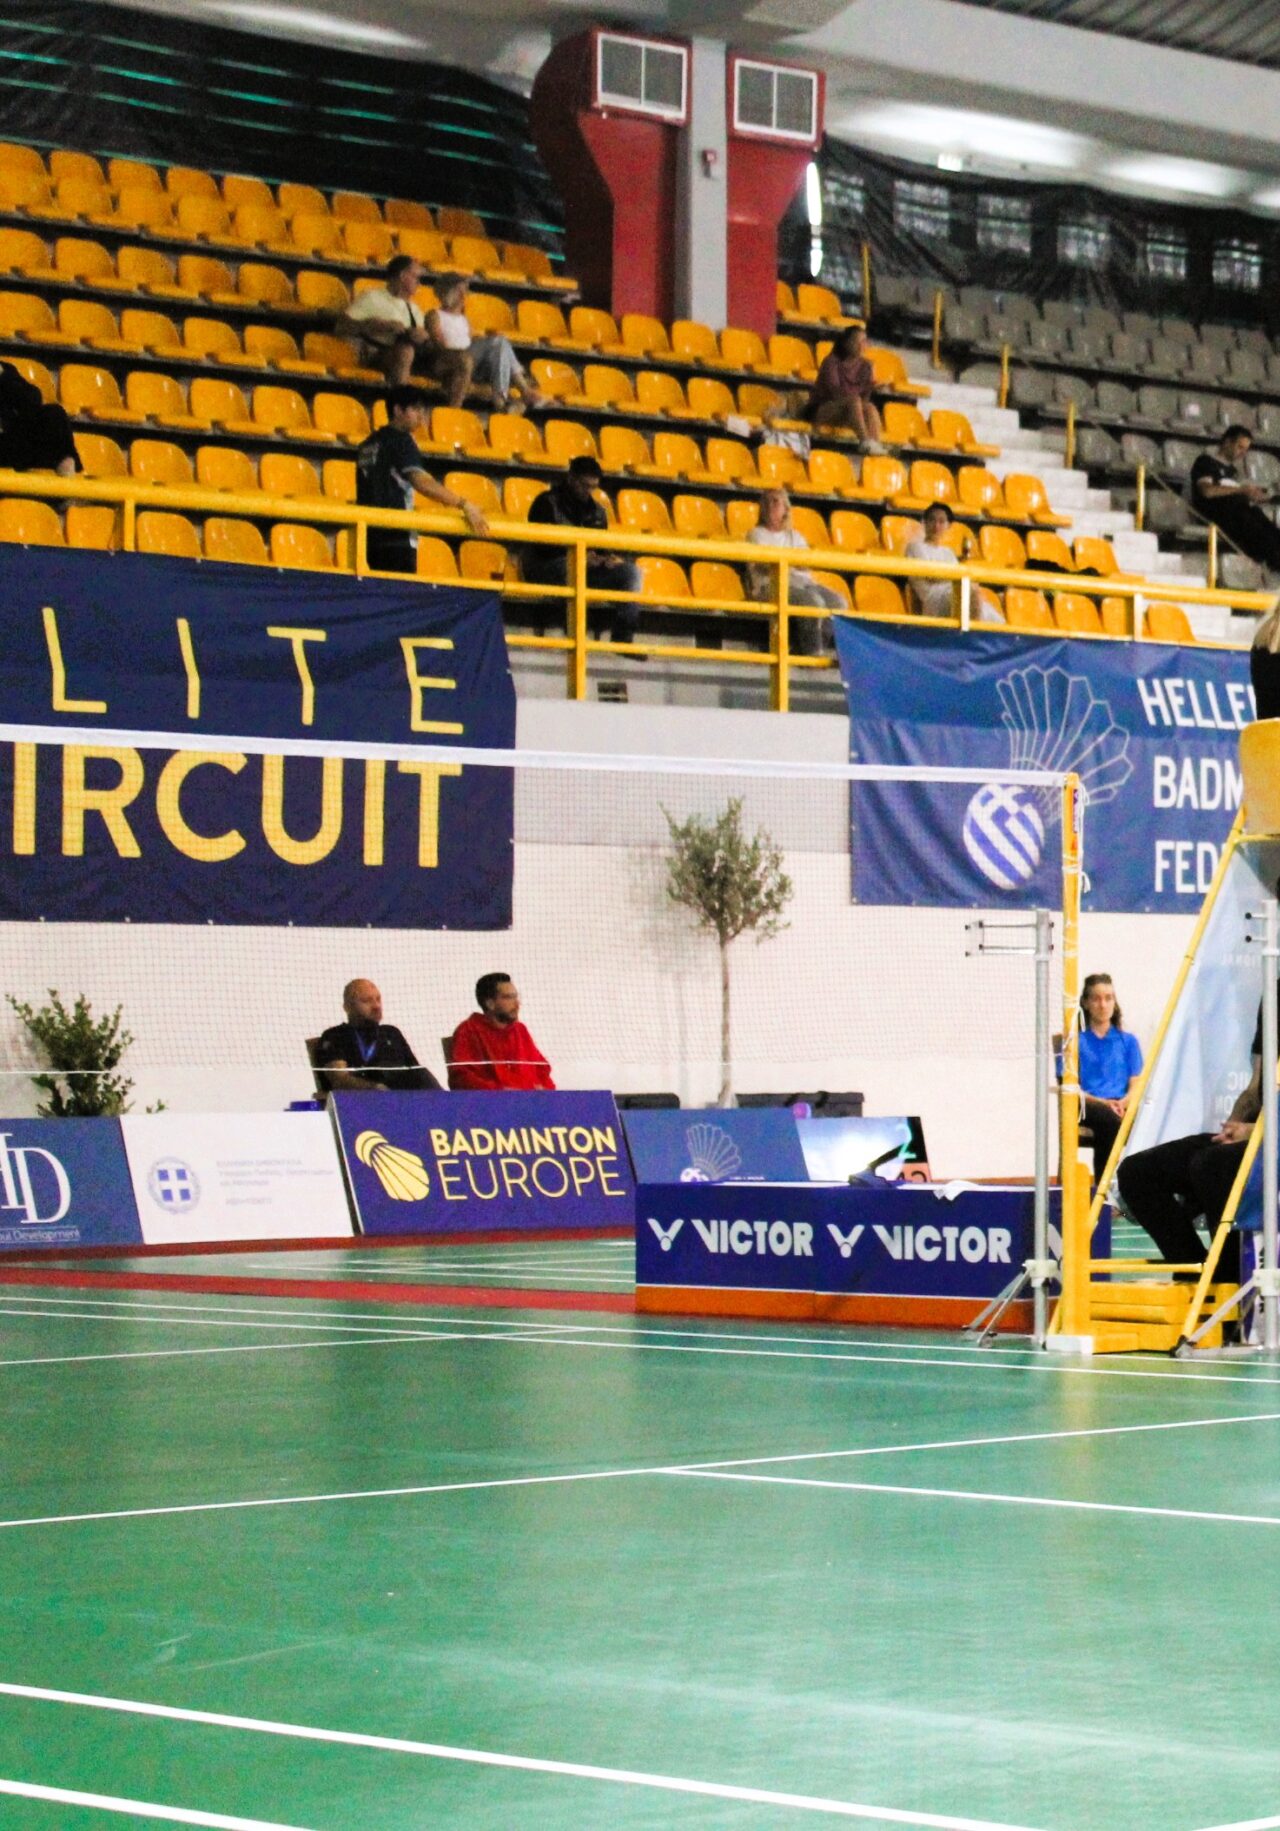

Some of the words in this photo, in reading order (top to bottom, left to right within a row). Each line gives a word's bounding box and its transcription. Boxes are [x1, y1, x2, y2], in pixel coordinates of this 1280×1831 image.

[429, 1126, 617, 1156] BADMINTON
[437, 1156, 627, 1200] EUROPE
[691, 1219, 814, 1257] VICTOR
[872, 1224, 1012, 1264] VICTOR
